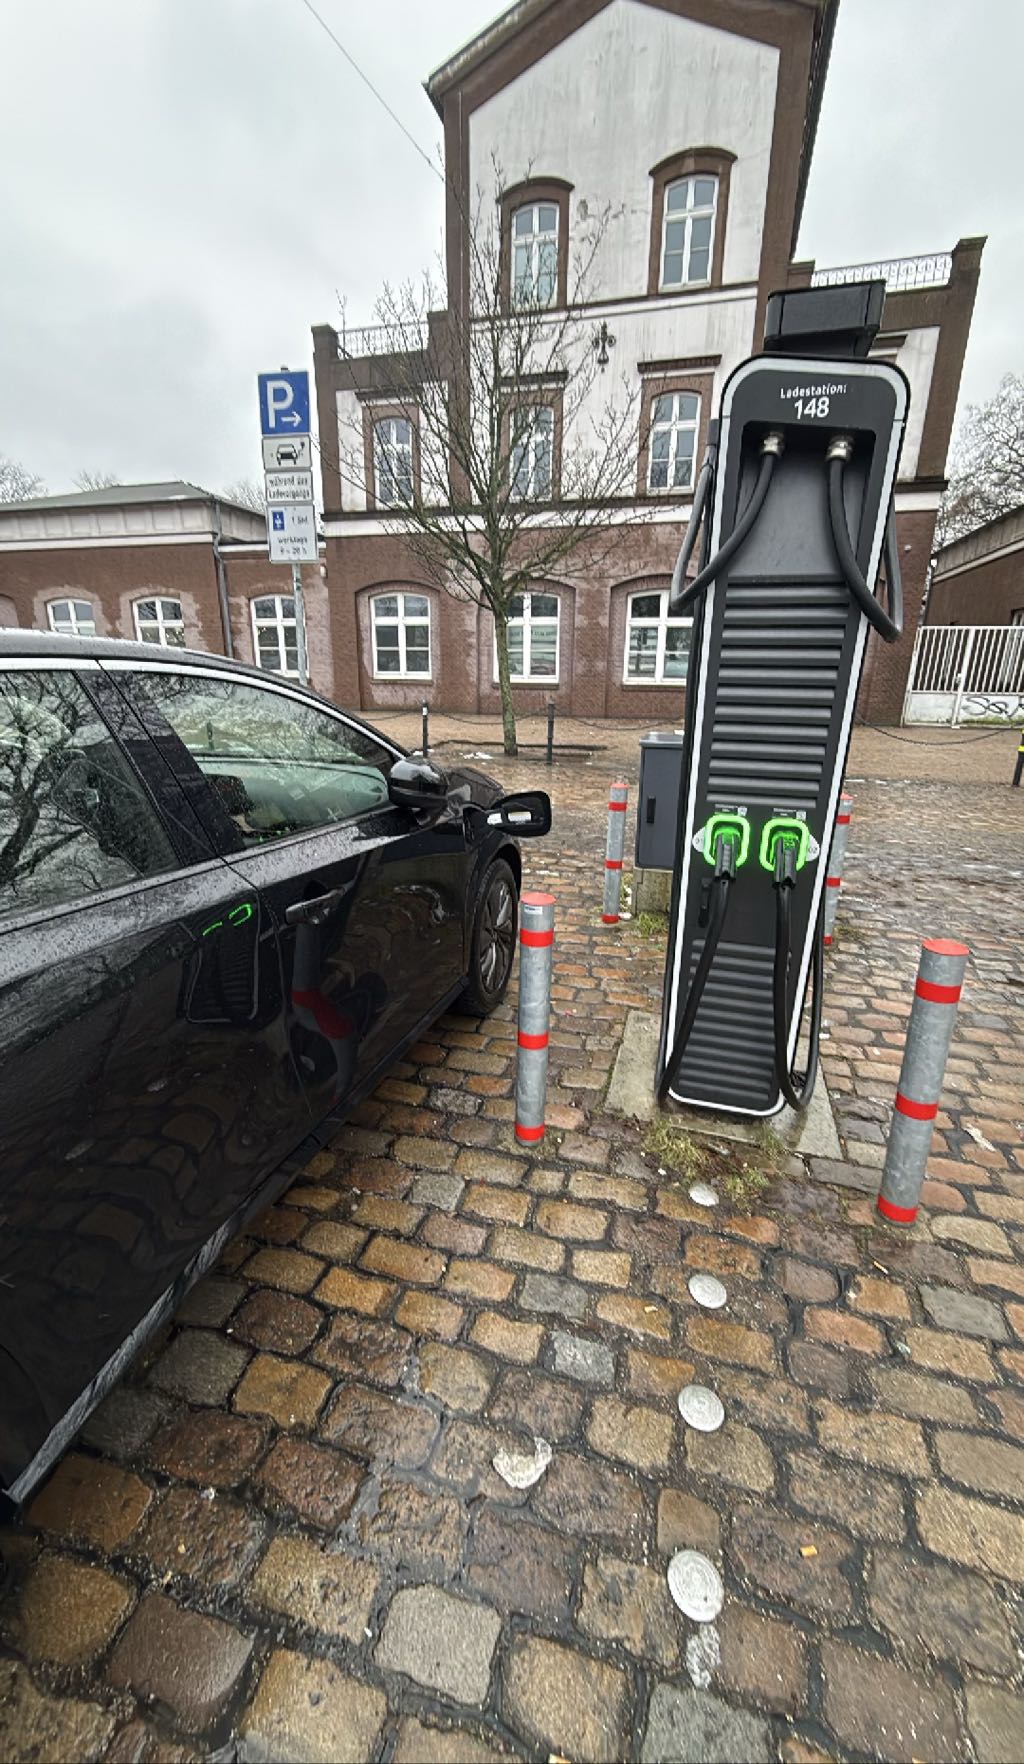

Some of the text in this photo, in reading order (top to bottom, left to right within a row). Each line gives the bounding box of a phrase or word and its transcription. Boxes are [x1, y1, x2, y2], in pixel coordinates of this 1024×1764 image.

[780, 383, 847, 399] Ladestation:
[266, 380, 294, 428] P
[794, 396, 830, 420] 148
